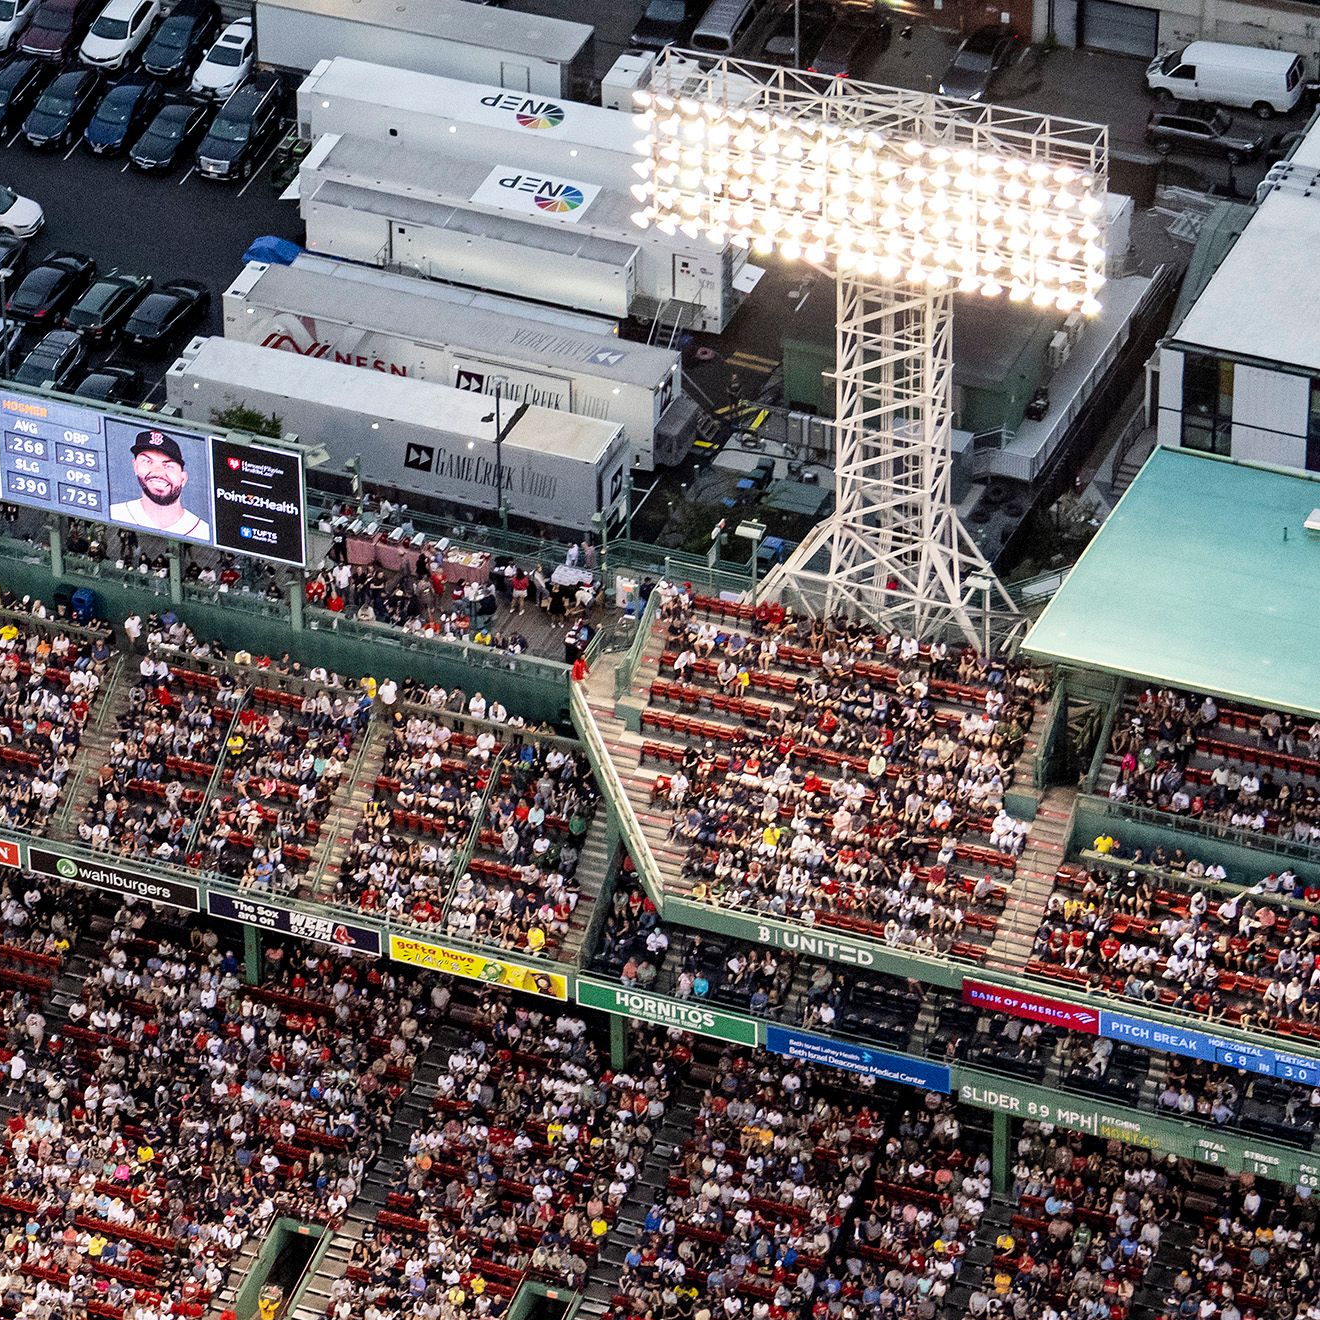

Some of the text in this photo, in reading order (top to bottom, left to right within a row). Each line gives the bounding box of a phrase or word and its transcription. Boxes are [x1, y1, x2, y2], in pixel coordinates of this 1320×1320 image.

[480, 94, 545, 115] NEP
[498, 175, 564, 197] NEP
[2, 400, 48, 418] HOSMER
[14, 420, 89, 445] AVG OBP
[9, 437, 96, 467] .268 .335
[15, 459, 92, 485] SLG OPS
[11, 477, 98, 507] .390 .725
[217, 488, 299, 515] Point32Health
[253, 528, 277, 539] TUFTS
[77, 868, 172, 899] wahlburgers
[232, 900, 279, 919] The Sox
[238, 911, 275, 927] are on
[289, 912, 334, 934] WEEI
[396, 940, 475, 964] gotta have
[783, 931, 874, 967] UNITED
[971, 990, 1071, 1020] BANK OF AMERICA
[1111, 1022, 1197, 1050] PITCH BREAK
[789, 1039, 803, 1048] Beth
[804, 1043, 820, 1052] Israel
[840, 1051, 860, 1061] Health
[1209, 1039, 1317, 1069] HORIZONTAL VERTICAL
[789, 1047, 927, 1085] Beth Israel Deaconess Medical Center
[1224, 1052, 1307, 1080] 6.8 IN 3.0
[962, 1086, 1091, 1129] SLIDER 89 MPH
[1101, 1115, 1140, 1131] PITCHING
[1200, 1140, 1318, 1175] TOTAL STRIKES PCT
[1254, 1162, 1268, 1174] 13
